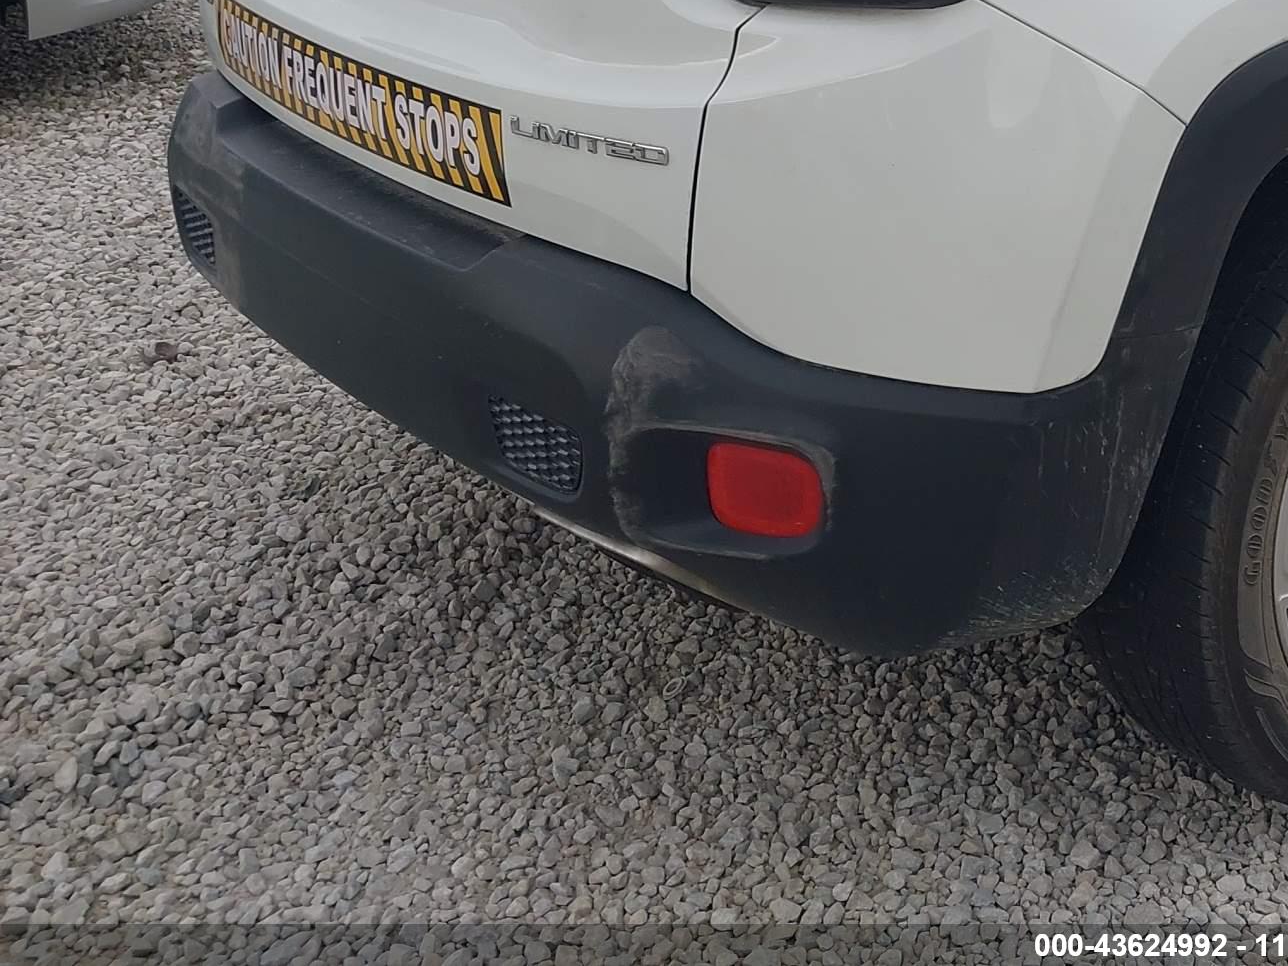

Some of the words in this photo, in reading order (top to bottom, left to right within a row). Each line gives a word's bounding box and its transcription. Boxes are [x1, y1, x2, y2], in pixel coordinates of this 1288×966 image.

[221, 6, 282, 91] CAUTION
[281, 46, 387, 141] FREQUENT
[393, 92, 482, 177] STOPS
[510, 115, 670, 167] LIMITED
